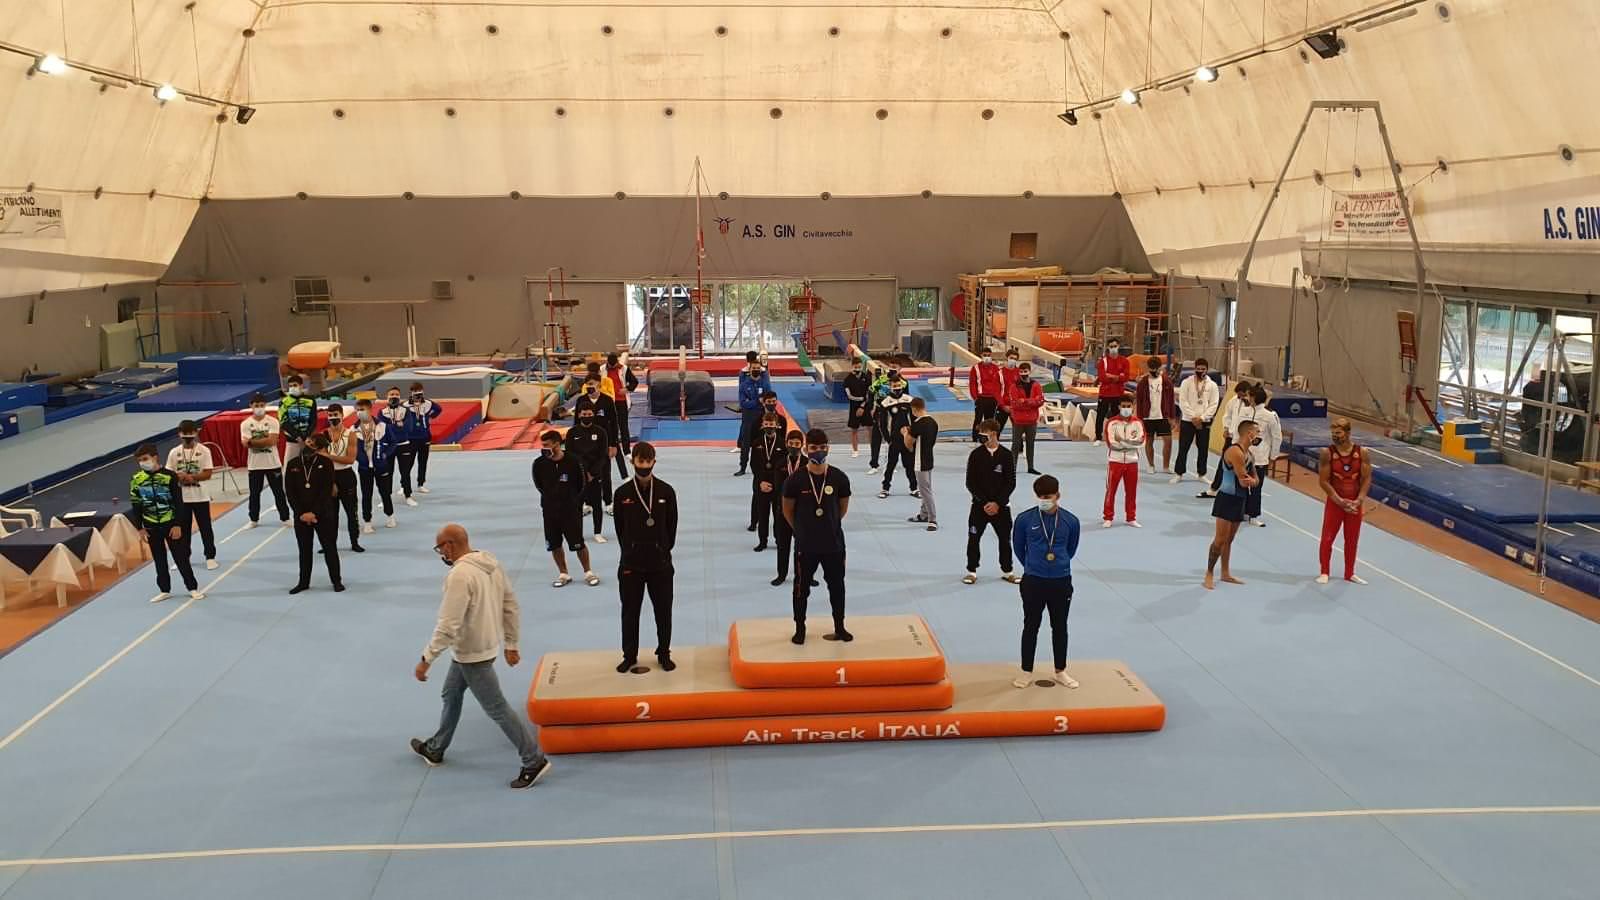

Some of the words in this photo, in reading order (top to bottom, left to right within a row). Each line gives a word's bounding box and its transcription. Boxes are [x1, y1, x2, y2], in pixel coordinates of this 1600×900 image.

[742, 224, 766, 238] A.S.
[773, 224, 796, 238] GIN
[802, 229, 853, 238] Civitavecchia
[1544, 206, 1572, 240] A.S.
[835, 667, 848, 684] 1
[635, 701, 651, 719] 2
[1054, 715, 1069, 732] 3
[742, 729, 782, 742] Air
[791, 727, 865, 740] Track
